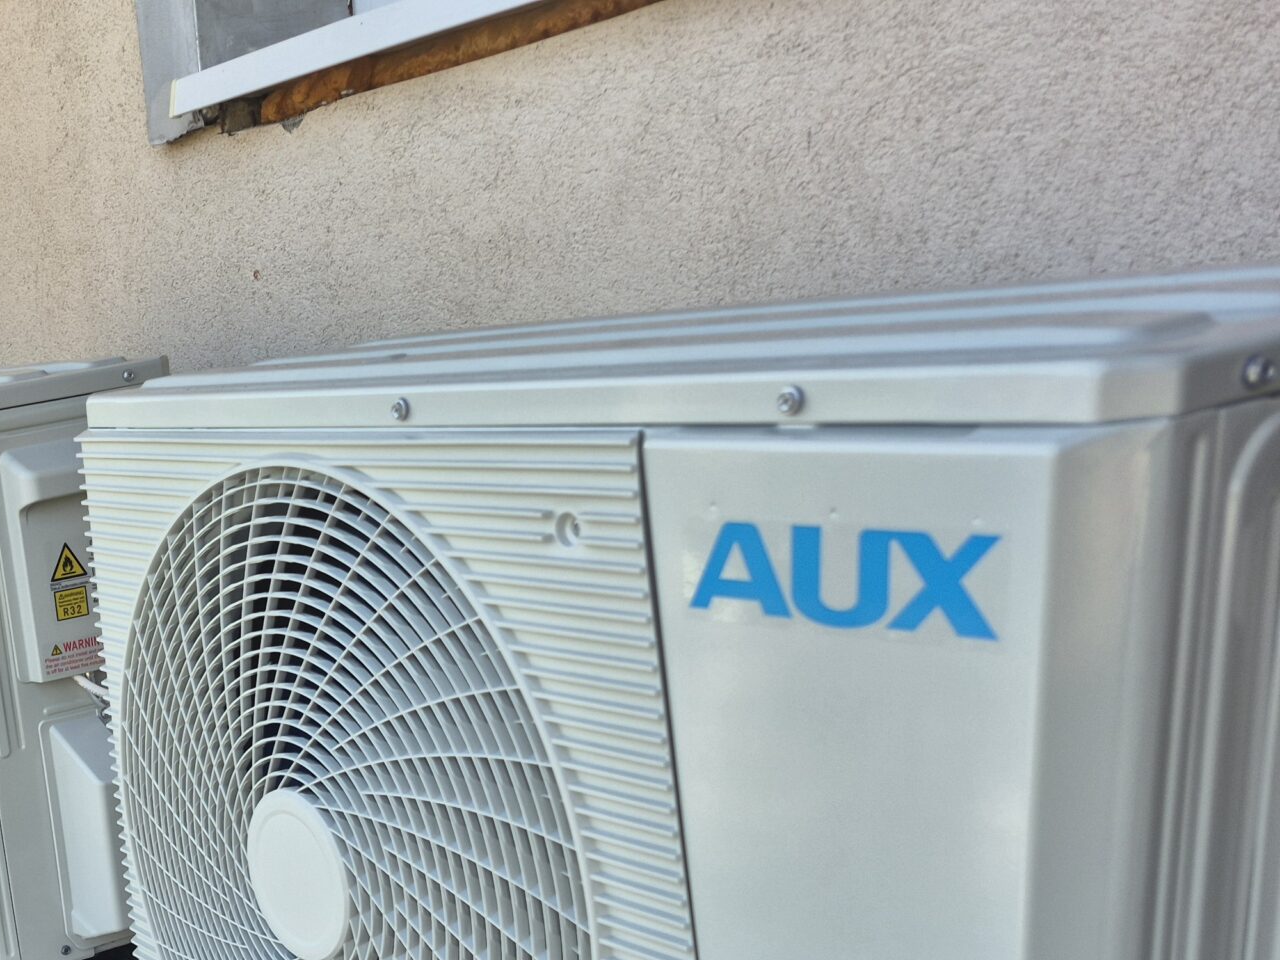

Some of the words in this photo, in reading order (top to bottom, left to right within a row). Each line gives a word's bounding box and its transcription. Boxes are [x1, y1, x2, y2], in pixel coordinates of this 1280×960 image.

[689, 521, 1002, 641] AUX
[63, 605, 82, 617] R32
[63, 636, 101, 652] WARNIN
